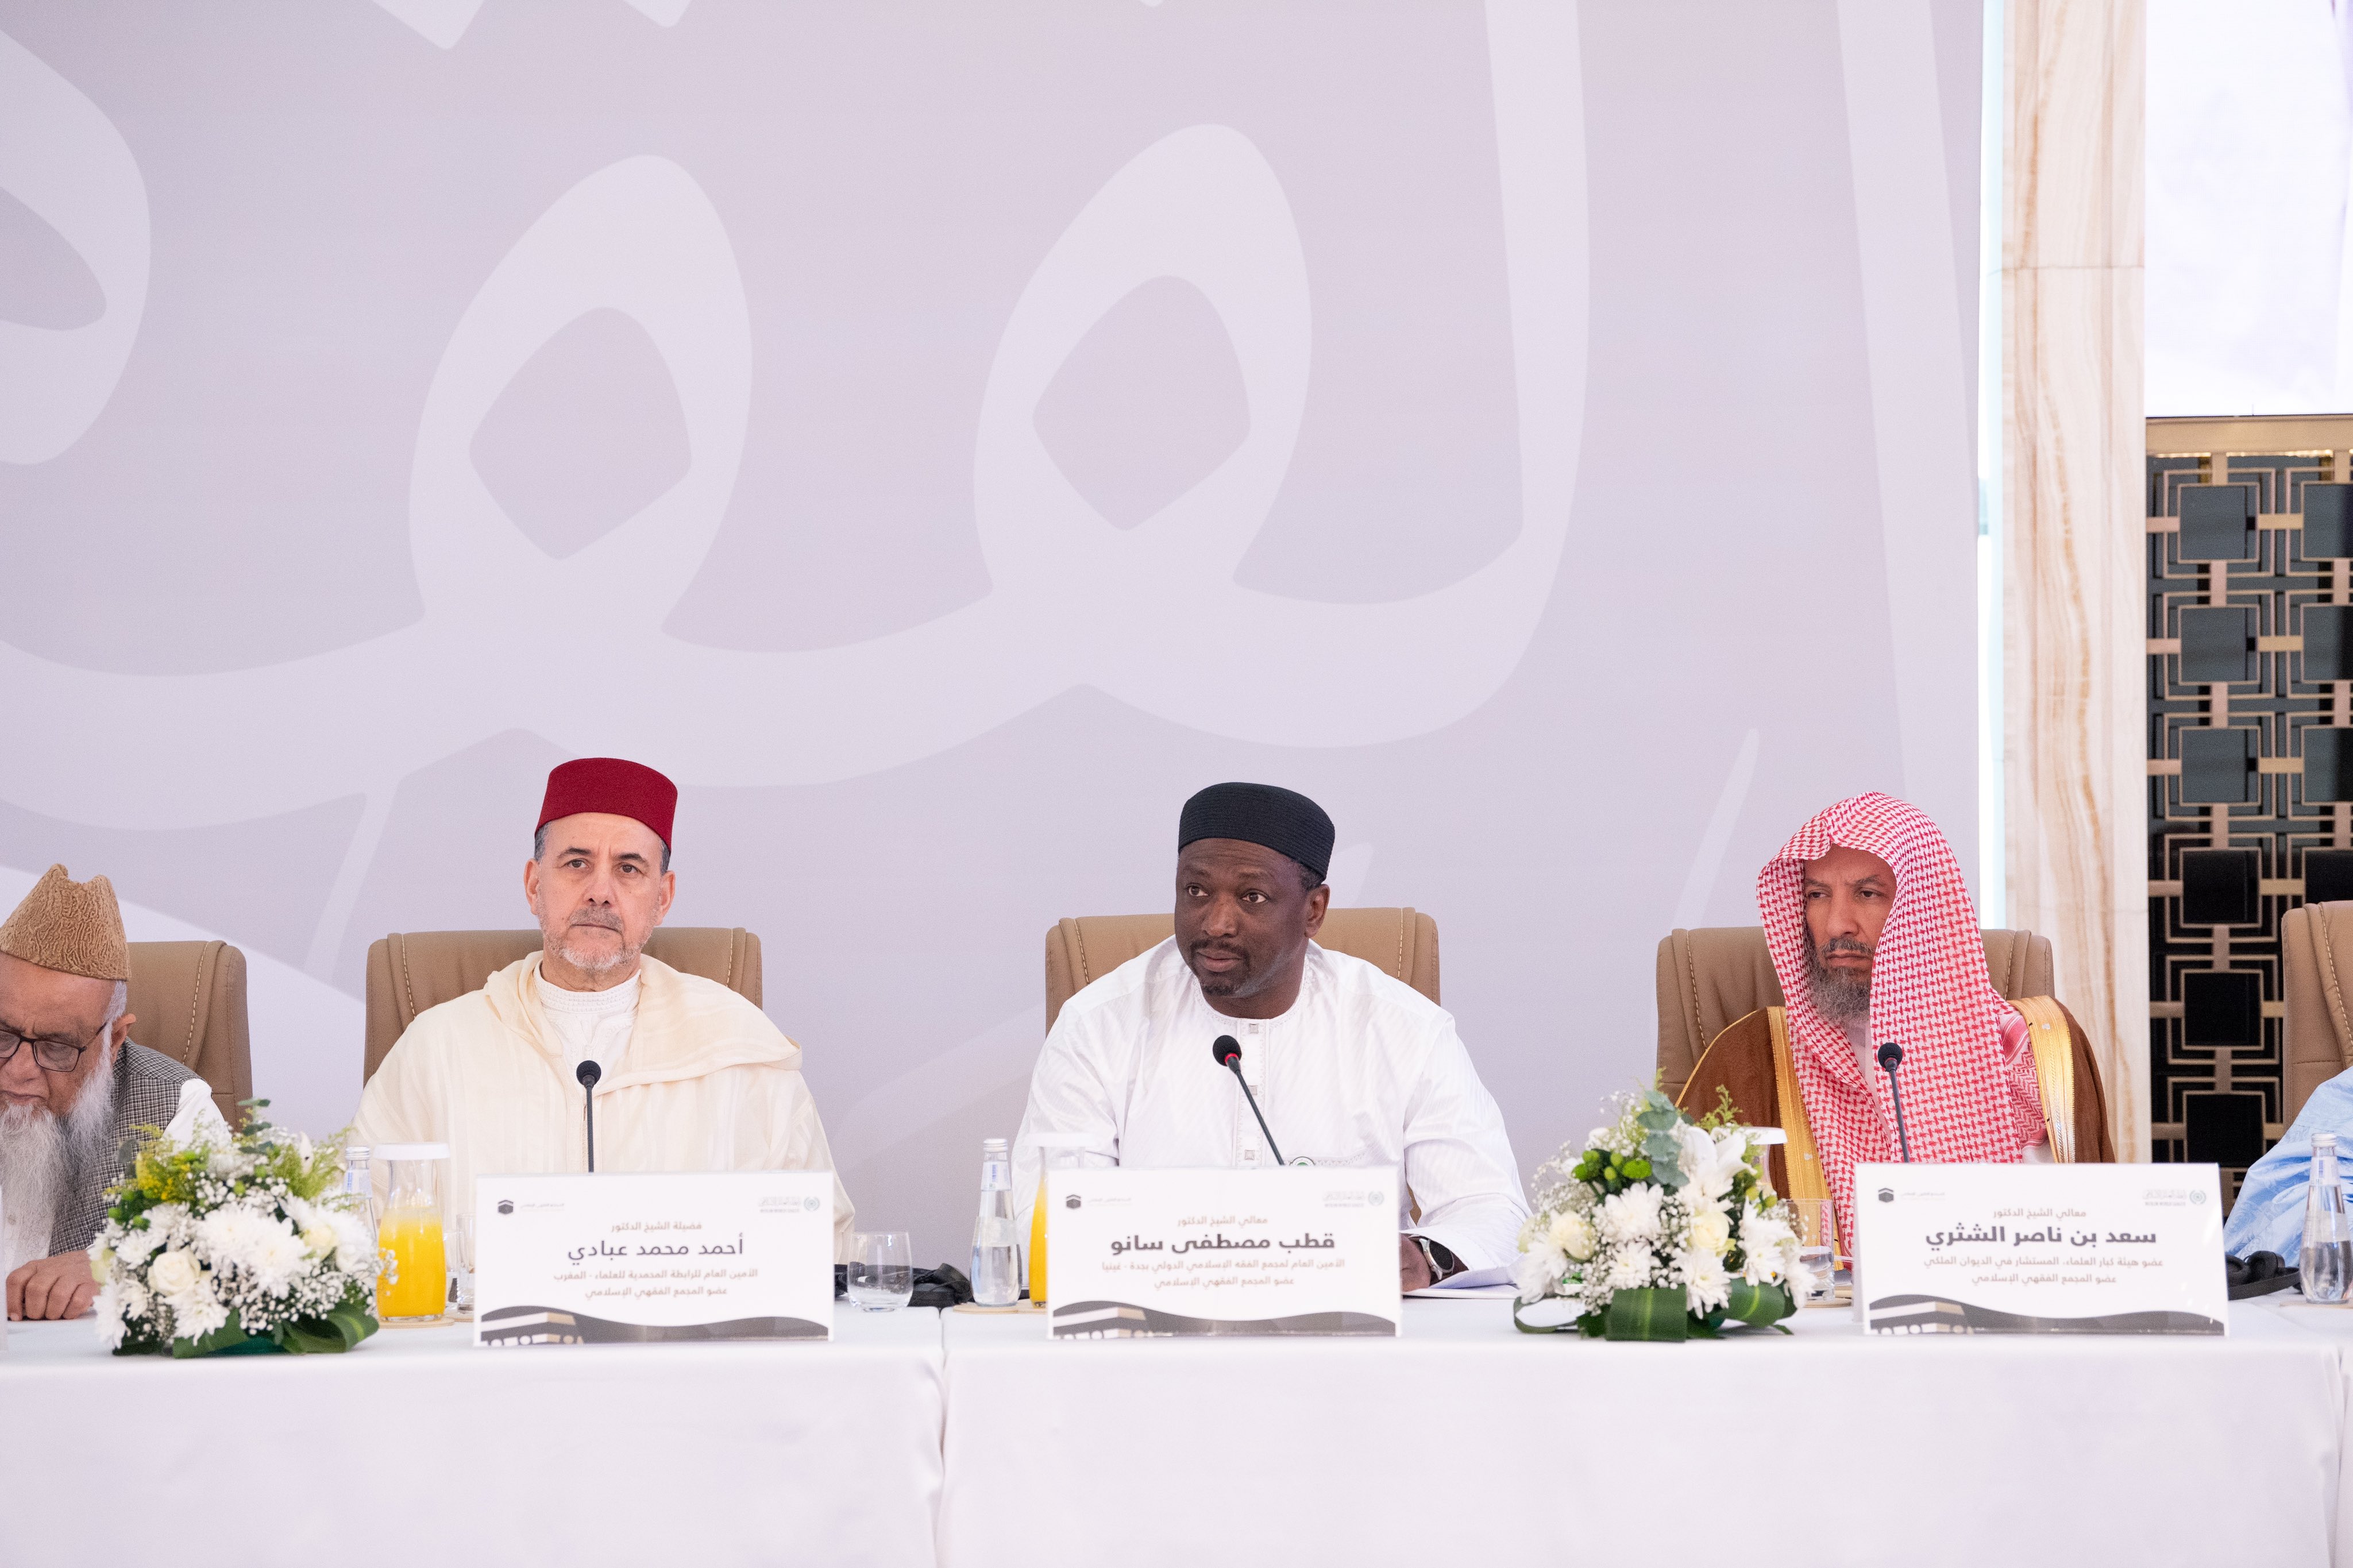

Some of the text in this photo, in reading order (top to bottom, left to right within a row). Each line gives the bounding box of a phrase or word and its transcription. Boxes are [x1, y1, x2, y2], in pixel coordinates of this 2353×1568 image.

[1993, 1208, 2087, 1220] معالي الشيخ الدكتور
[611, 1221, 703, 1233] فضيلة الشيخ الدكتور
[1178, 1215, 1268, 1227] معالي الشيخ الدكتور
[1926, 1222, 2157, 1252] سعد بن ناصر الشثري
[568, 1232, 743, 1266] أحمد محمد عبادي
[1110, 1233, 1335, 1256] قطب مصطفى سانو
[1102, 1262, 1121, 1273] غينيا
[1129, 1261, 1150, 1270] بجدة
[1151, 1260, 1184, 1273] الدولي
[1235, 1260, 1259, 1268] الفقه
[1261, 1259, 1289, 1271] لمجمع
[1291, 1259, 1314, 1270] العام
[1923, 1256, 1957, 1269] الملكي
[1959, 1256, 1992, 1267] الديوان
[1995, 1258, 2013, 1269] في
[2015, 1256, 2059, 1267] المستشار
[2099, 1257, 2115, 1268] كبار
[2117, 1257, 2139, 1269] هيئة
[2142, 1258, 2163, 1269] عضو
[553, 1270, 587, 1282] المغرب
[595, 1270, 626, 1280] للعلماء
[627, 1269, 668, 1281] المحمدية
[670, 1269, 701, 1280] للرابطة
[703, 1269, 727, 1281] العام
[2021, 1273, 2058, 1287] الفقهي
[2061, 1273, 2093, 1285] المجمع
[2095, 1276, 2117, 1285] عضو
[1202, 1276, 1239, 1290] الفقهي
[1241, 1276, 1271, 1288] المجمع
[1273, 1279, 1294, 1287] عضو
[634, 1286, 671, 1300] الفقهي
[673, 1286, 704, 1298] المجمع
[706, 1288, 727, 1297] عضو
